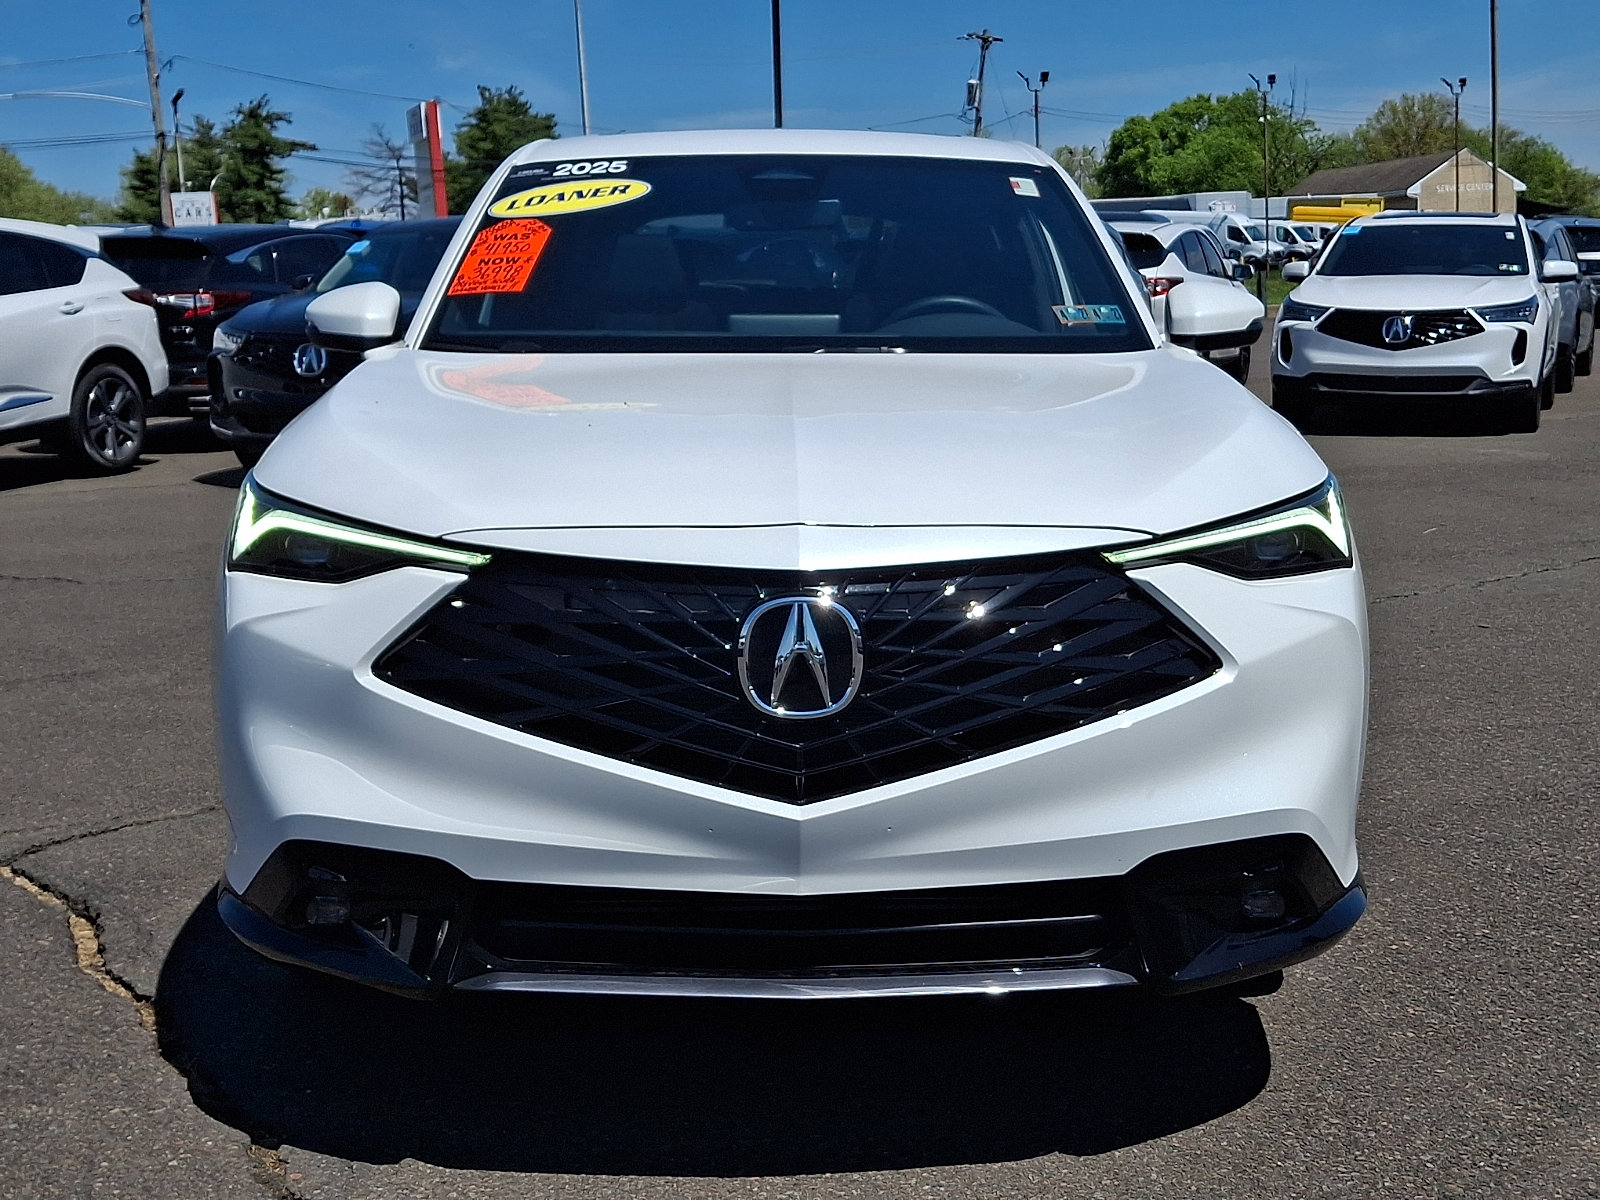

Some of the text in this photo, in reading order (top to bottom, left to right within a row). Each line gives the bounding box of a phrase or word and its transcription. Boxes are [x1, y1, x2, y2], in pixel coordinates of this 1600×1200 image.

[552, 161, 628, 177] 2025
[505, 184, 632, 211] LOANER
[493, 232, 532, 241] WAS
[485, 241, 531, 256] 41950
[477, 256, 522, 266] NOW
[472, 265, 524, 280] 36998
